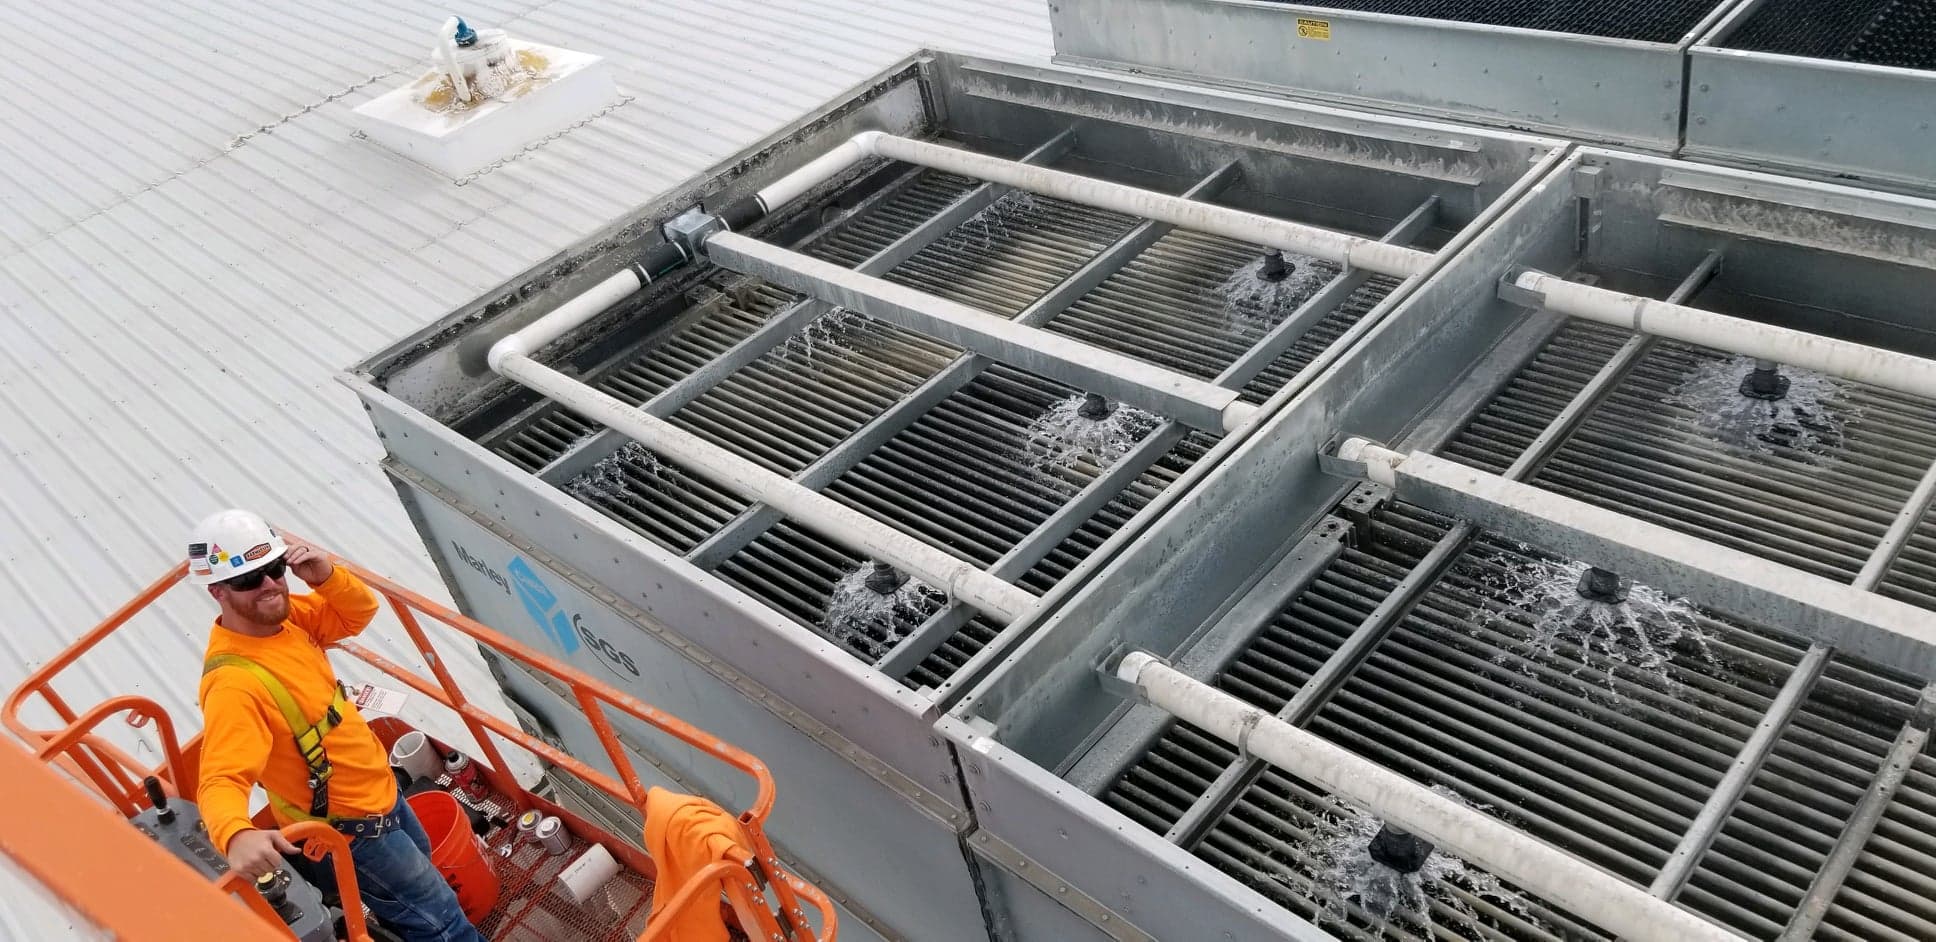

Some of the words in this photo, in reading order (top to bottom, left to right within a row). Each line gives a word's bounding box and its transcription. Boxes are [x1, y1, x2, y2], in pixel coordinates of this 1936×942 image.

[1298, 19, 1328, 27] CAUTION
[451, 540, 511, 595] Marley
[579, 624, 640, 678] SGS
